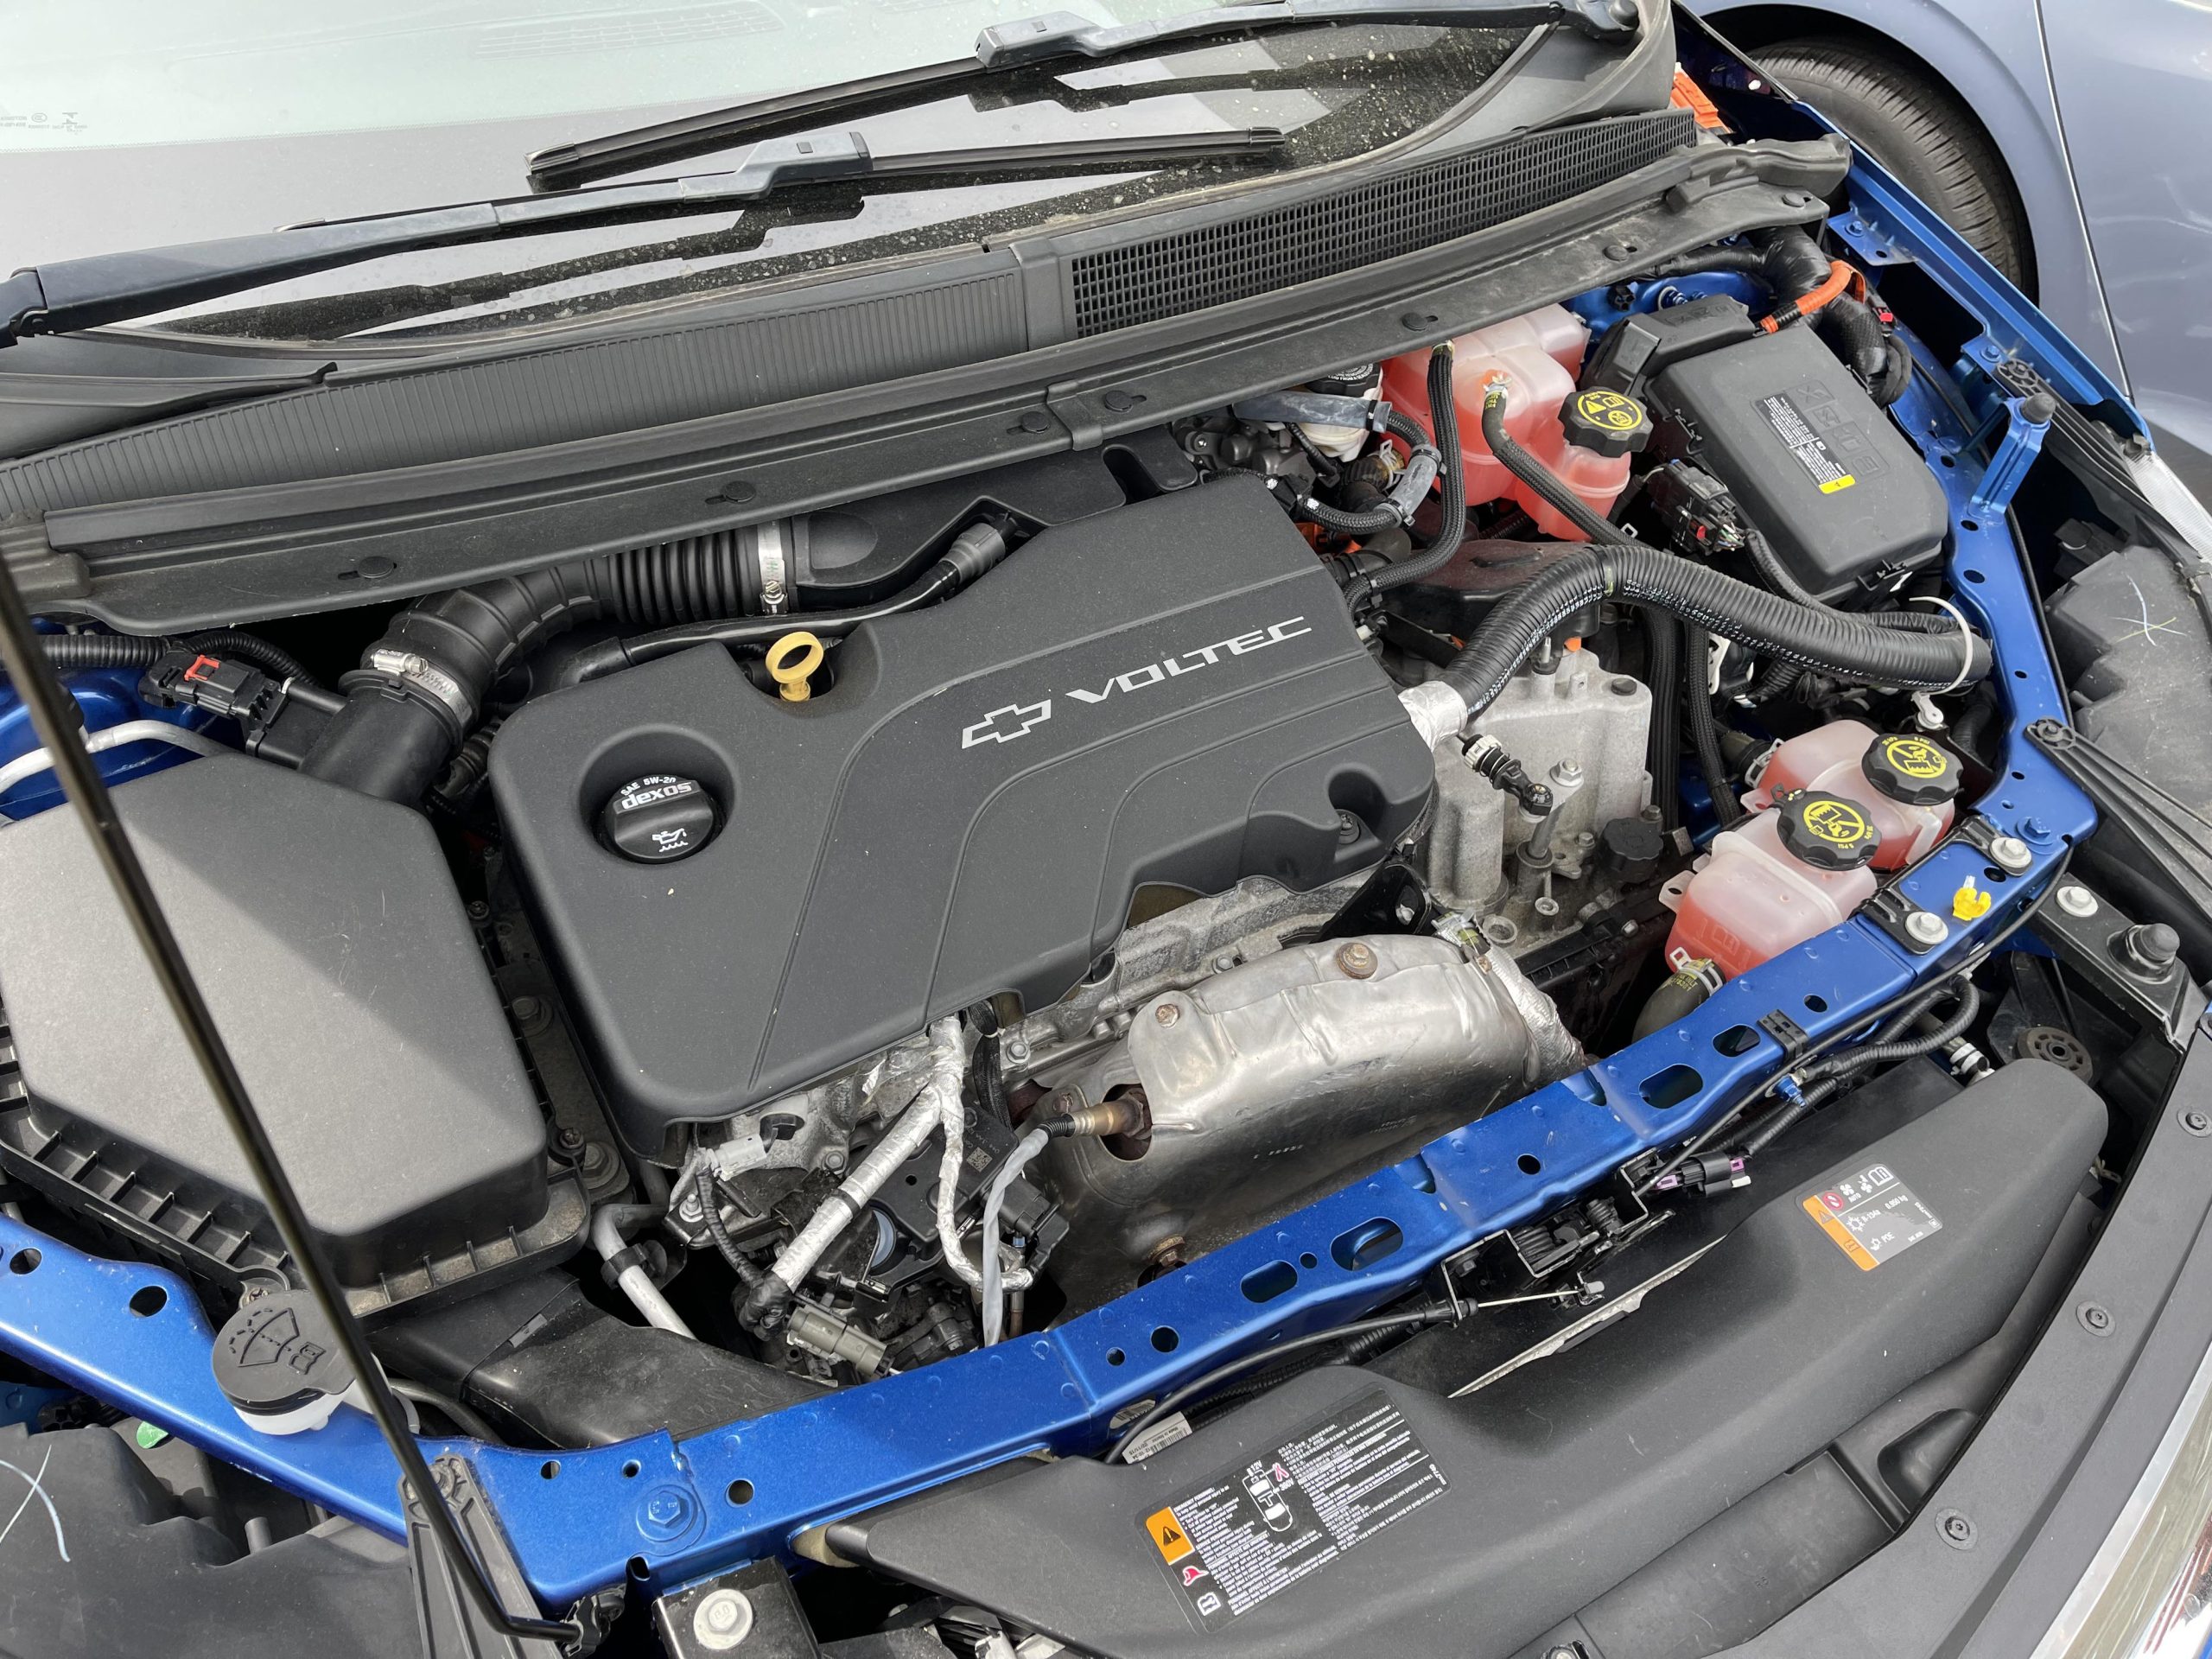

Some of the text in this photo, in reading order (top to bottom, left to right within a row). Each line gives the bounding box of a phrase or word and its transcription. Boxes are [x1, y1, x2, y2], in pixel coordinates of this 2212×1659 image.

[1065, 615, 1313, 704] VOLTEC
[620, 782, 641, 796] SAE
[621, 782, 692, 810] dexos
[1848, 1193, 1861, 1203] AUTO
[1250, 1459, 1262, 1471] 12V
